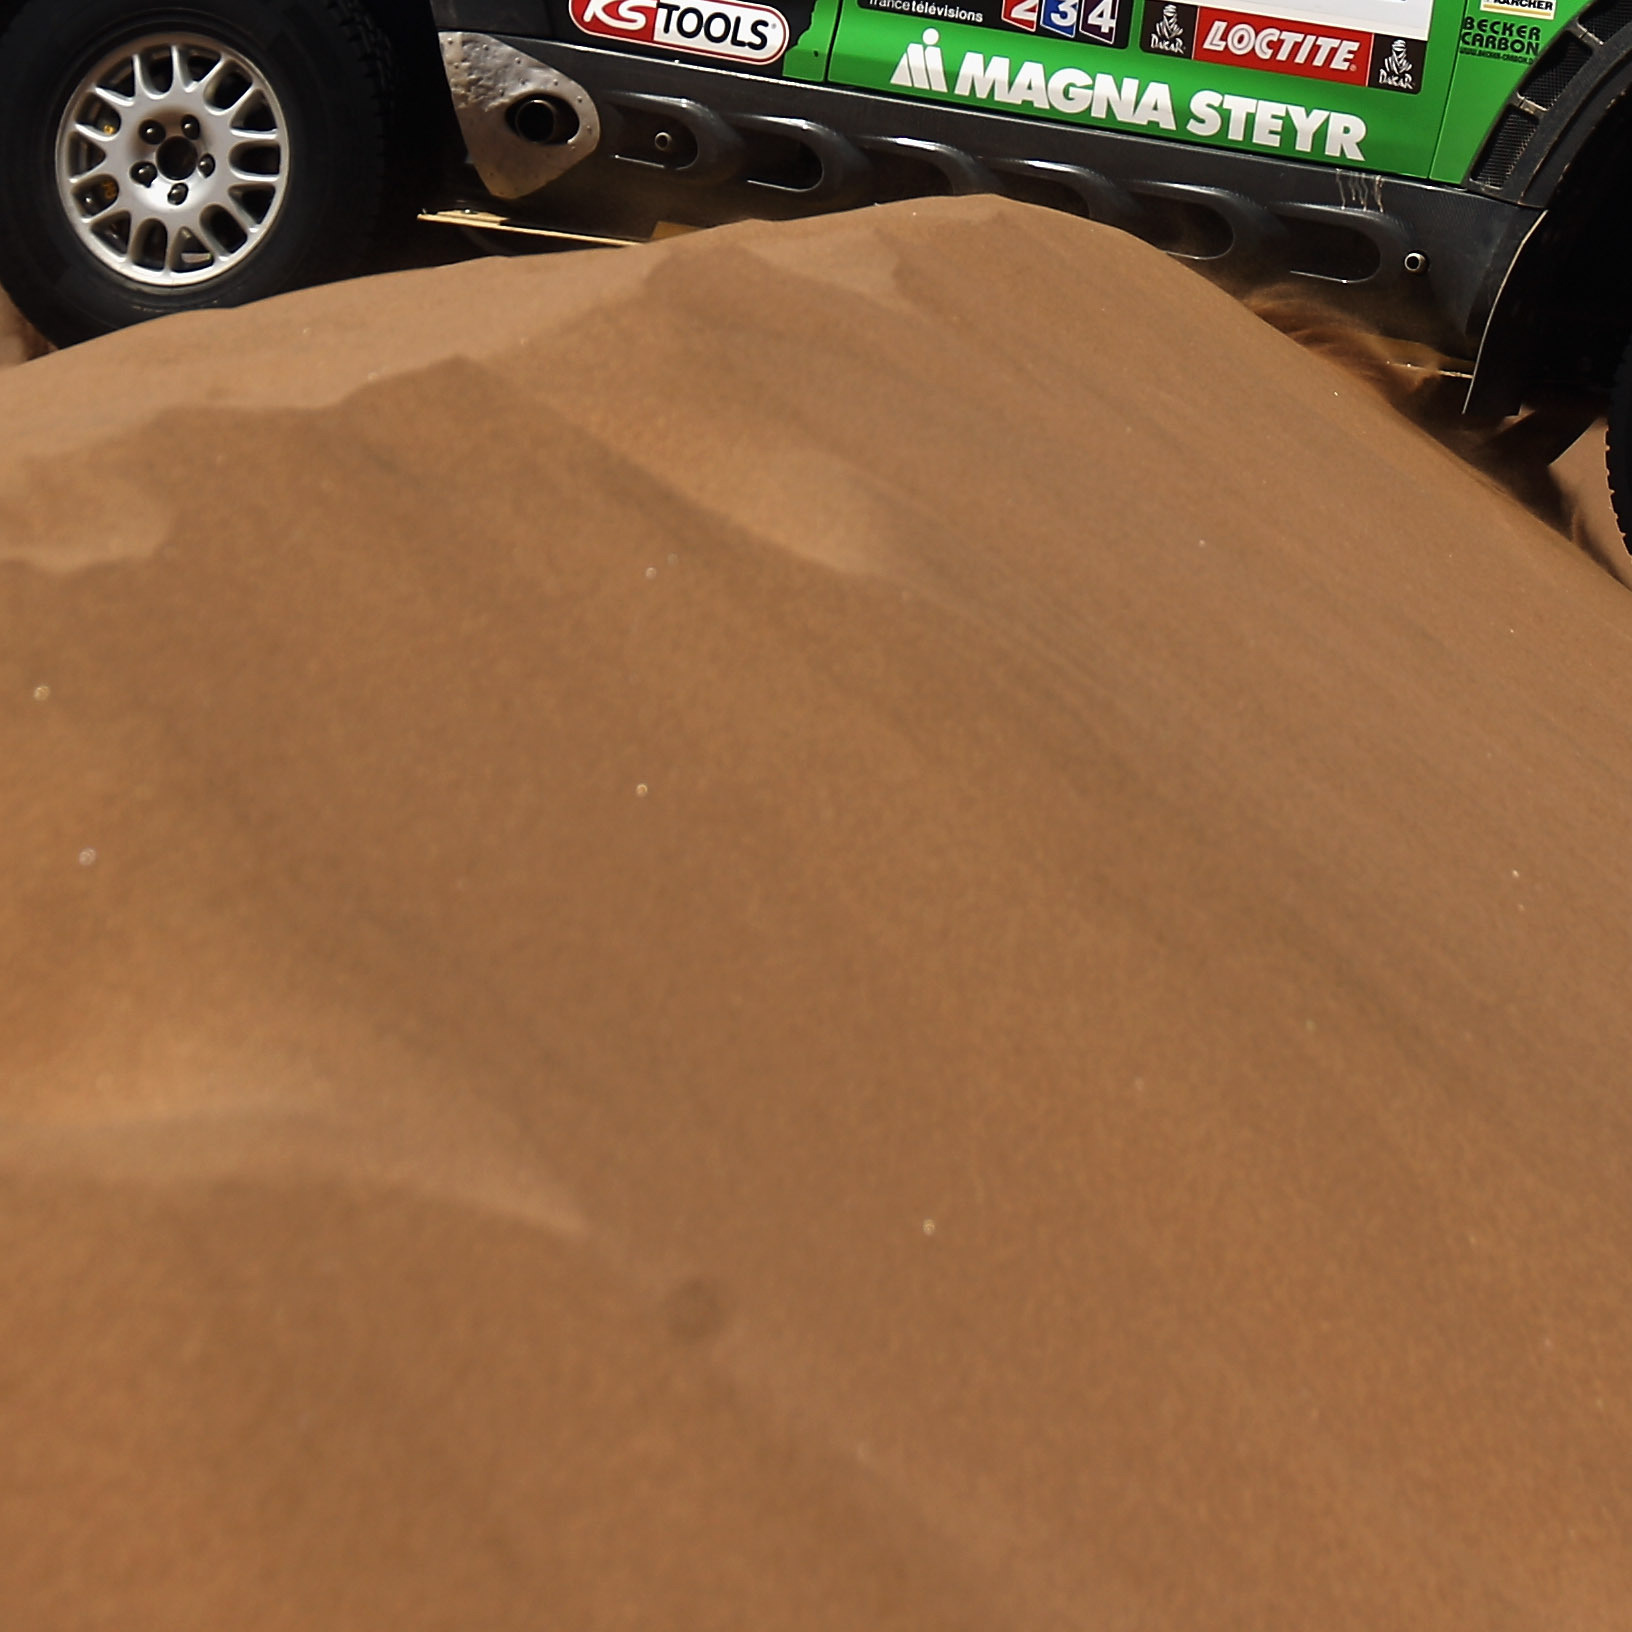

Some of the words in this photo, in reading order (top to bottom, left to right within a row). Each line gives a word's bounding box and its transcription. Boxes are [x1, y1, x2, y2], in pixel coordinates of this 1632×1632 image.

[656, 1, 769, 51] TOOLS
[1202, 20, 1361, 71] LOCTITE
[1460, 31, 1541, 56] CARBON
[1462, 16, 1542, 42] BECKER
[954, 51, 1177, 131] MAGNA
[1186, 89, 1367, 162] STEYR
